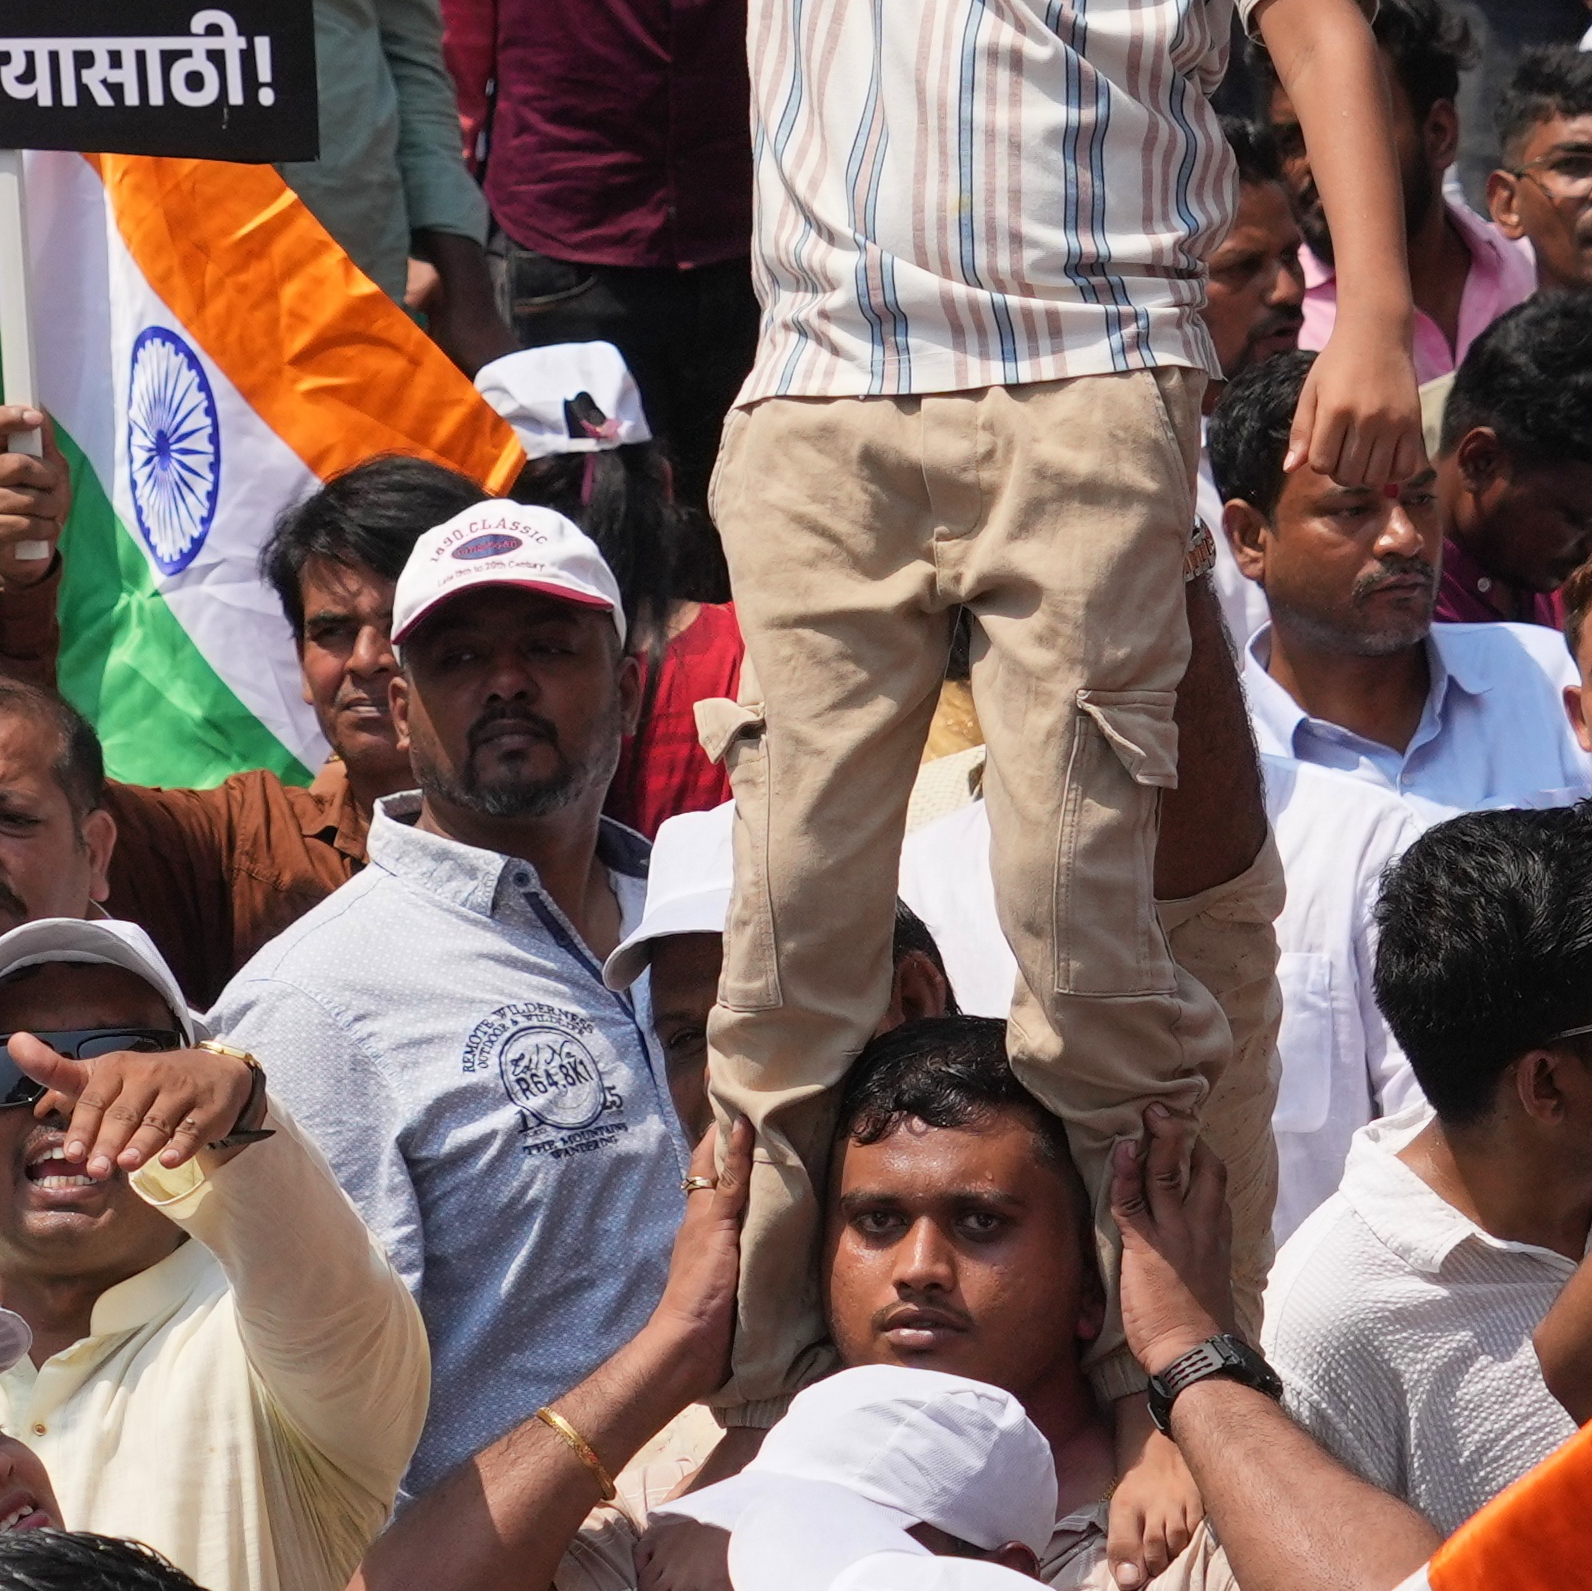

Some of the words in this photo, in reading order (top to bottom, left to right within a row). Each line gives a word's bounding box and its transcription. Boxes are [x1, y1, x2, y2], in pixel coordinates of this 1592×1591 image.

[469, 517, 548, 545] CLASSIC
[462, 1018, 495, 1073] REMOTE
[491, 1002, 596, 1035] WILDERNESS
[477, 1022, 510, 1069] OUTDOOR
[550, 1135, 619, 1160] WANDERING
[560, 1122, 629, 1147] MOUNTAINS
